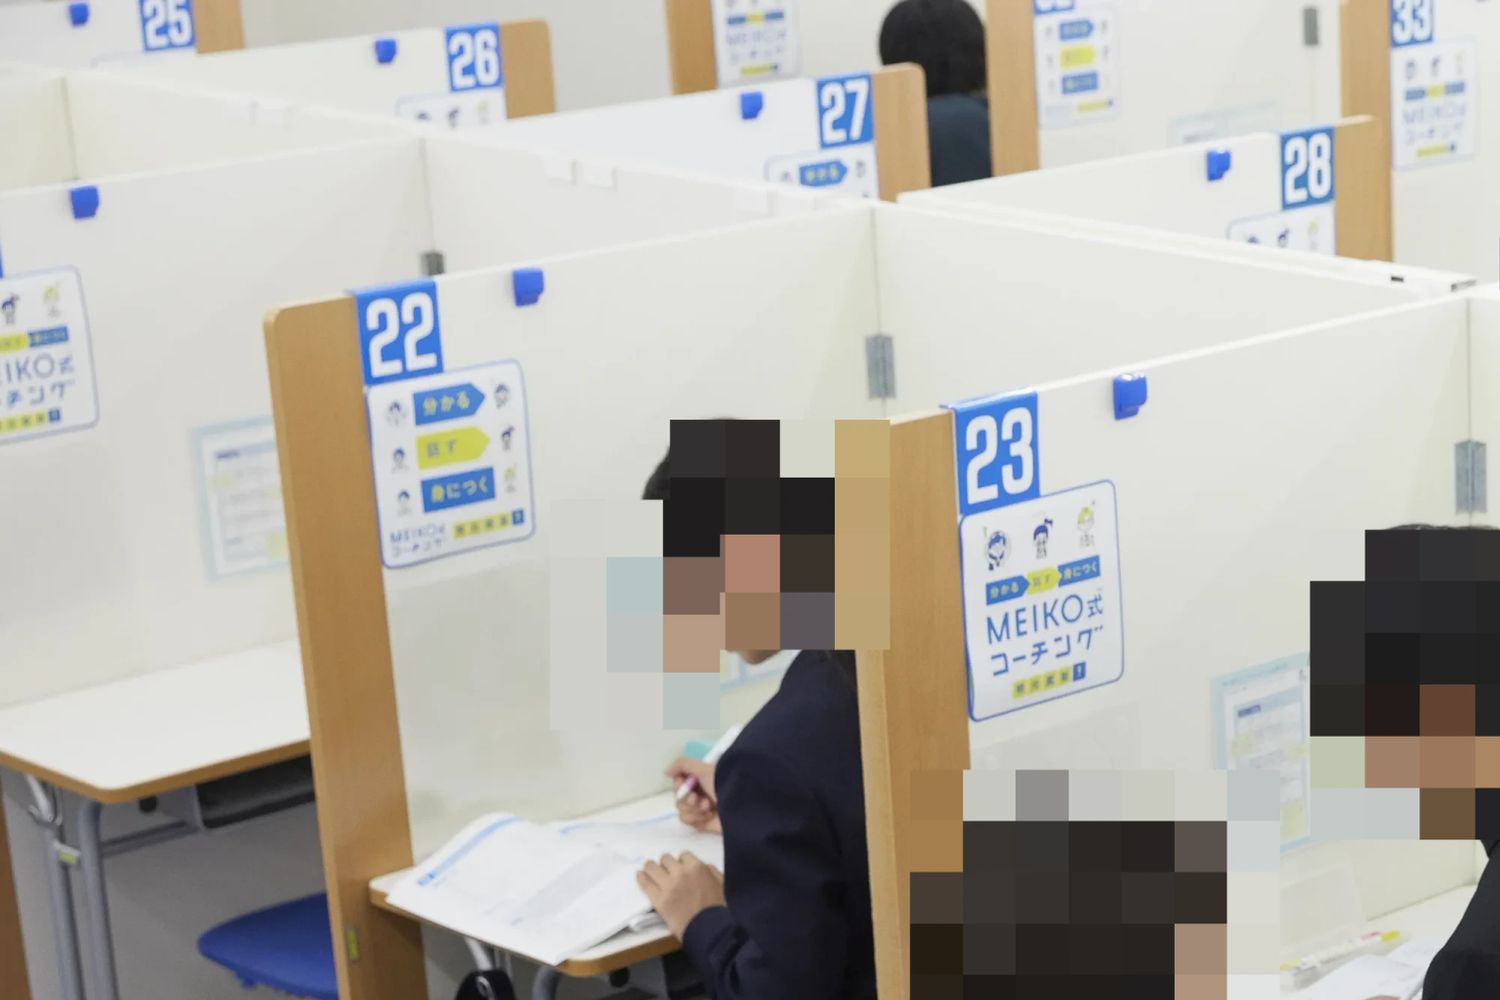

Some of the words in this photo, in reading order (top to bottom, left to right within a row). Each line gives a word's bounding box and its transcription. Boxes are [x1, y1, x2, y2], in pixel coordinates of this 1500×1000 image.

[142, 0, 193, 48] 25
[1392, 0, 1432, 44] 33
[448, 28, 500, 90] 26
[820, 78, 870, 145] 27
[1284, 132, 1331, 205] 28
[366, 291, 438, 378] 22
[965, 406, 1034, 505] 23
[987, 588, 1104, 645] MEIKO式
[990, 625, 1104, 677] コーチング
